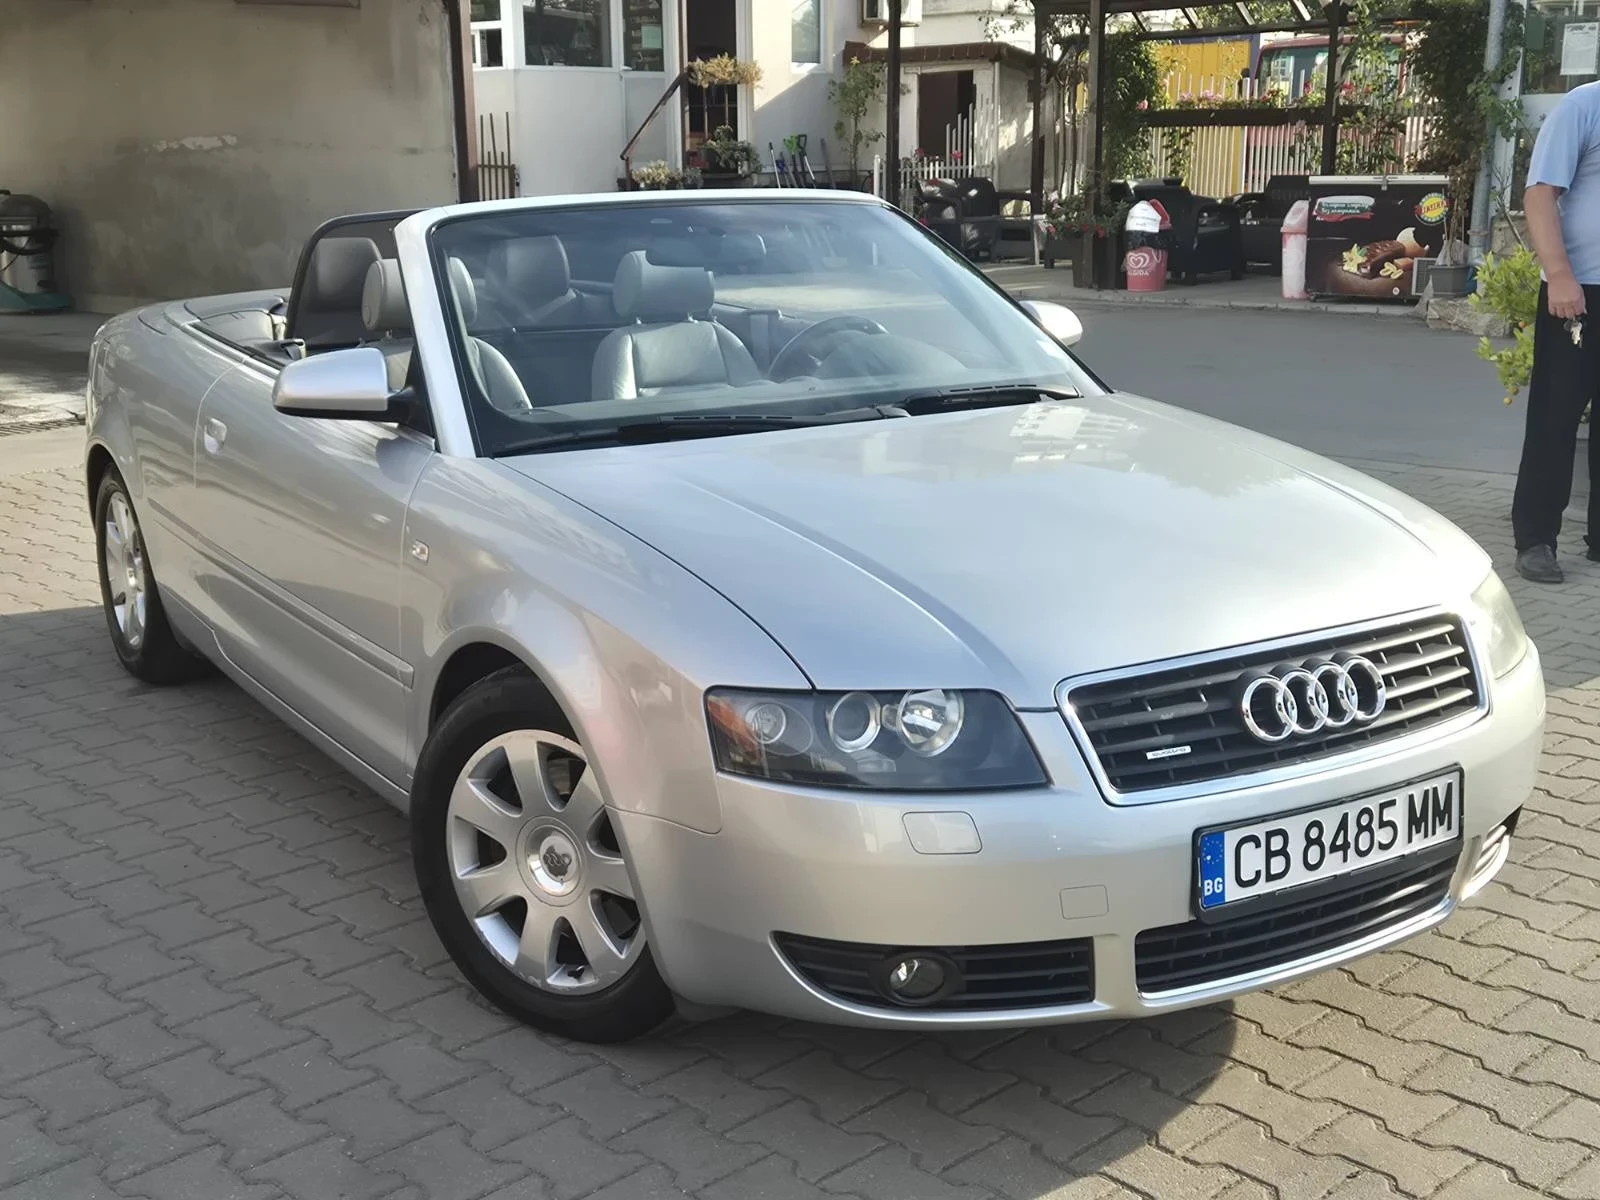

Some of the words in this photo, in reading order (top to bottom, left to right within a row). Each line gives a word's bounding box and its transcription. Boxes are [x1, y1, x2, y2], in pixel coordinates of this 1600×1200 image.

[1234, 828, 1291, 888] CB
[1302, 798, 1398, 872] 8485
[1407, 781, 1454, 844] MM
[1204, 878, 1223, 896] BG
